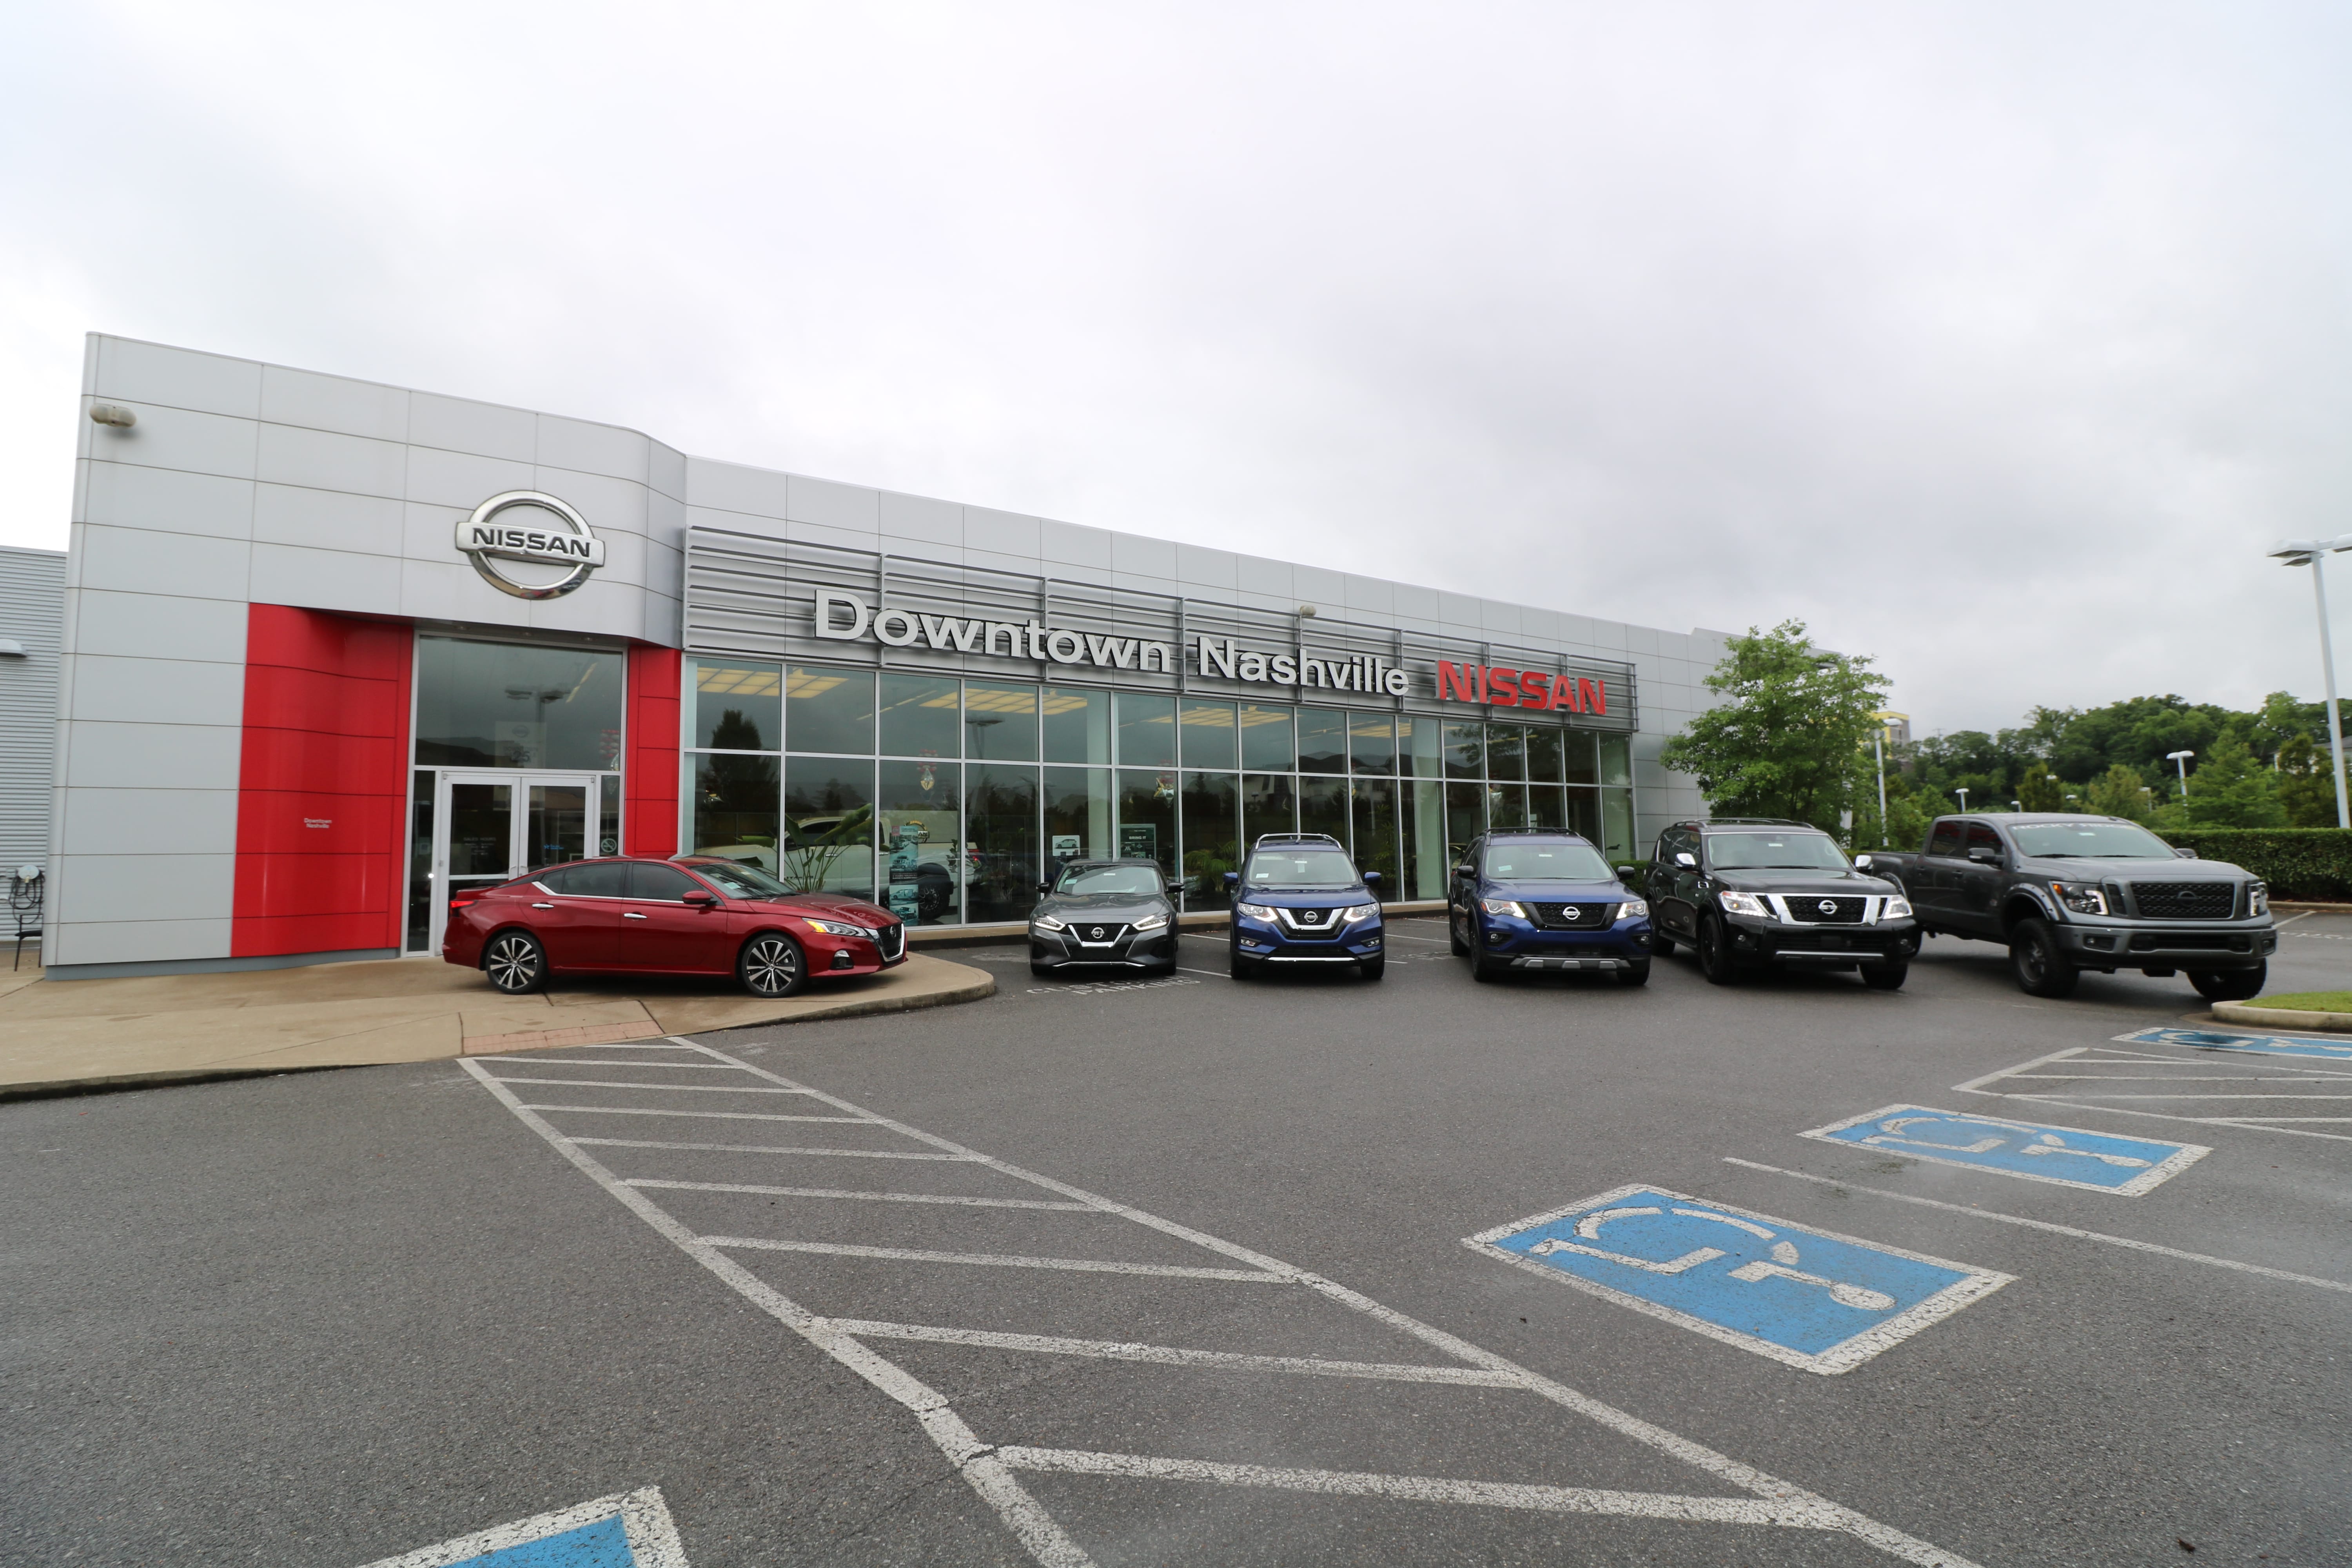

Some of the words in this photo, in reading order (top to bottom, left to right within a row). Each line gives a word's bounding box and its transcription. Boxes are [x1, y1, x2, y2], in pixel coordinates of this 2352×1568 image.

[473, 528, 590, 557] NISSAN
[815, 589, 1170, 672] Downtown
[1198, 637, 1409, 696] Nashville
[1436, 660, 1606, 715] NISSAN
[1071, 979, 1200, 995] PARKING
